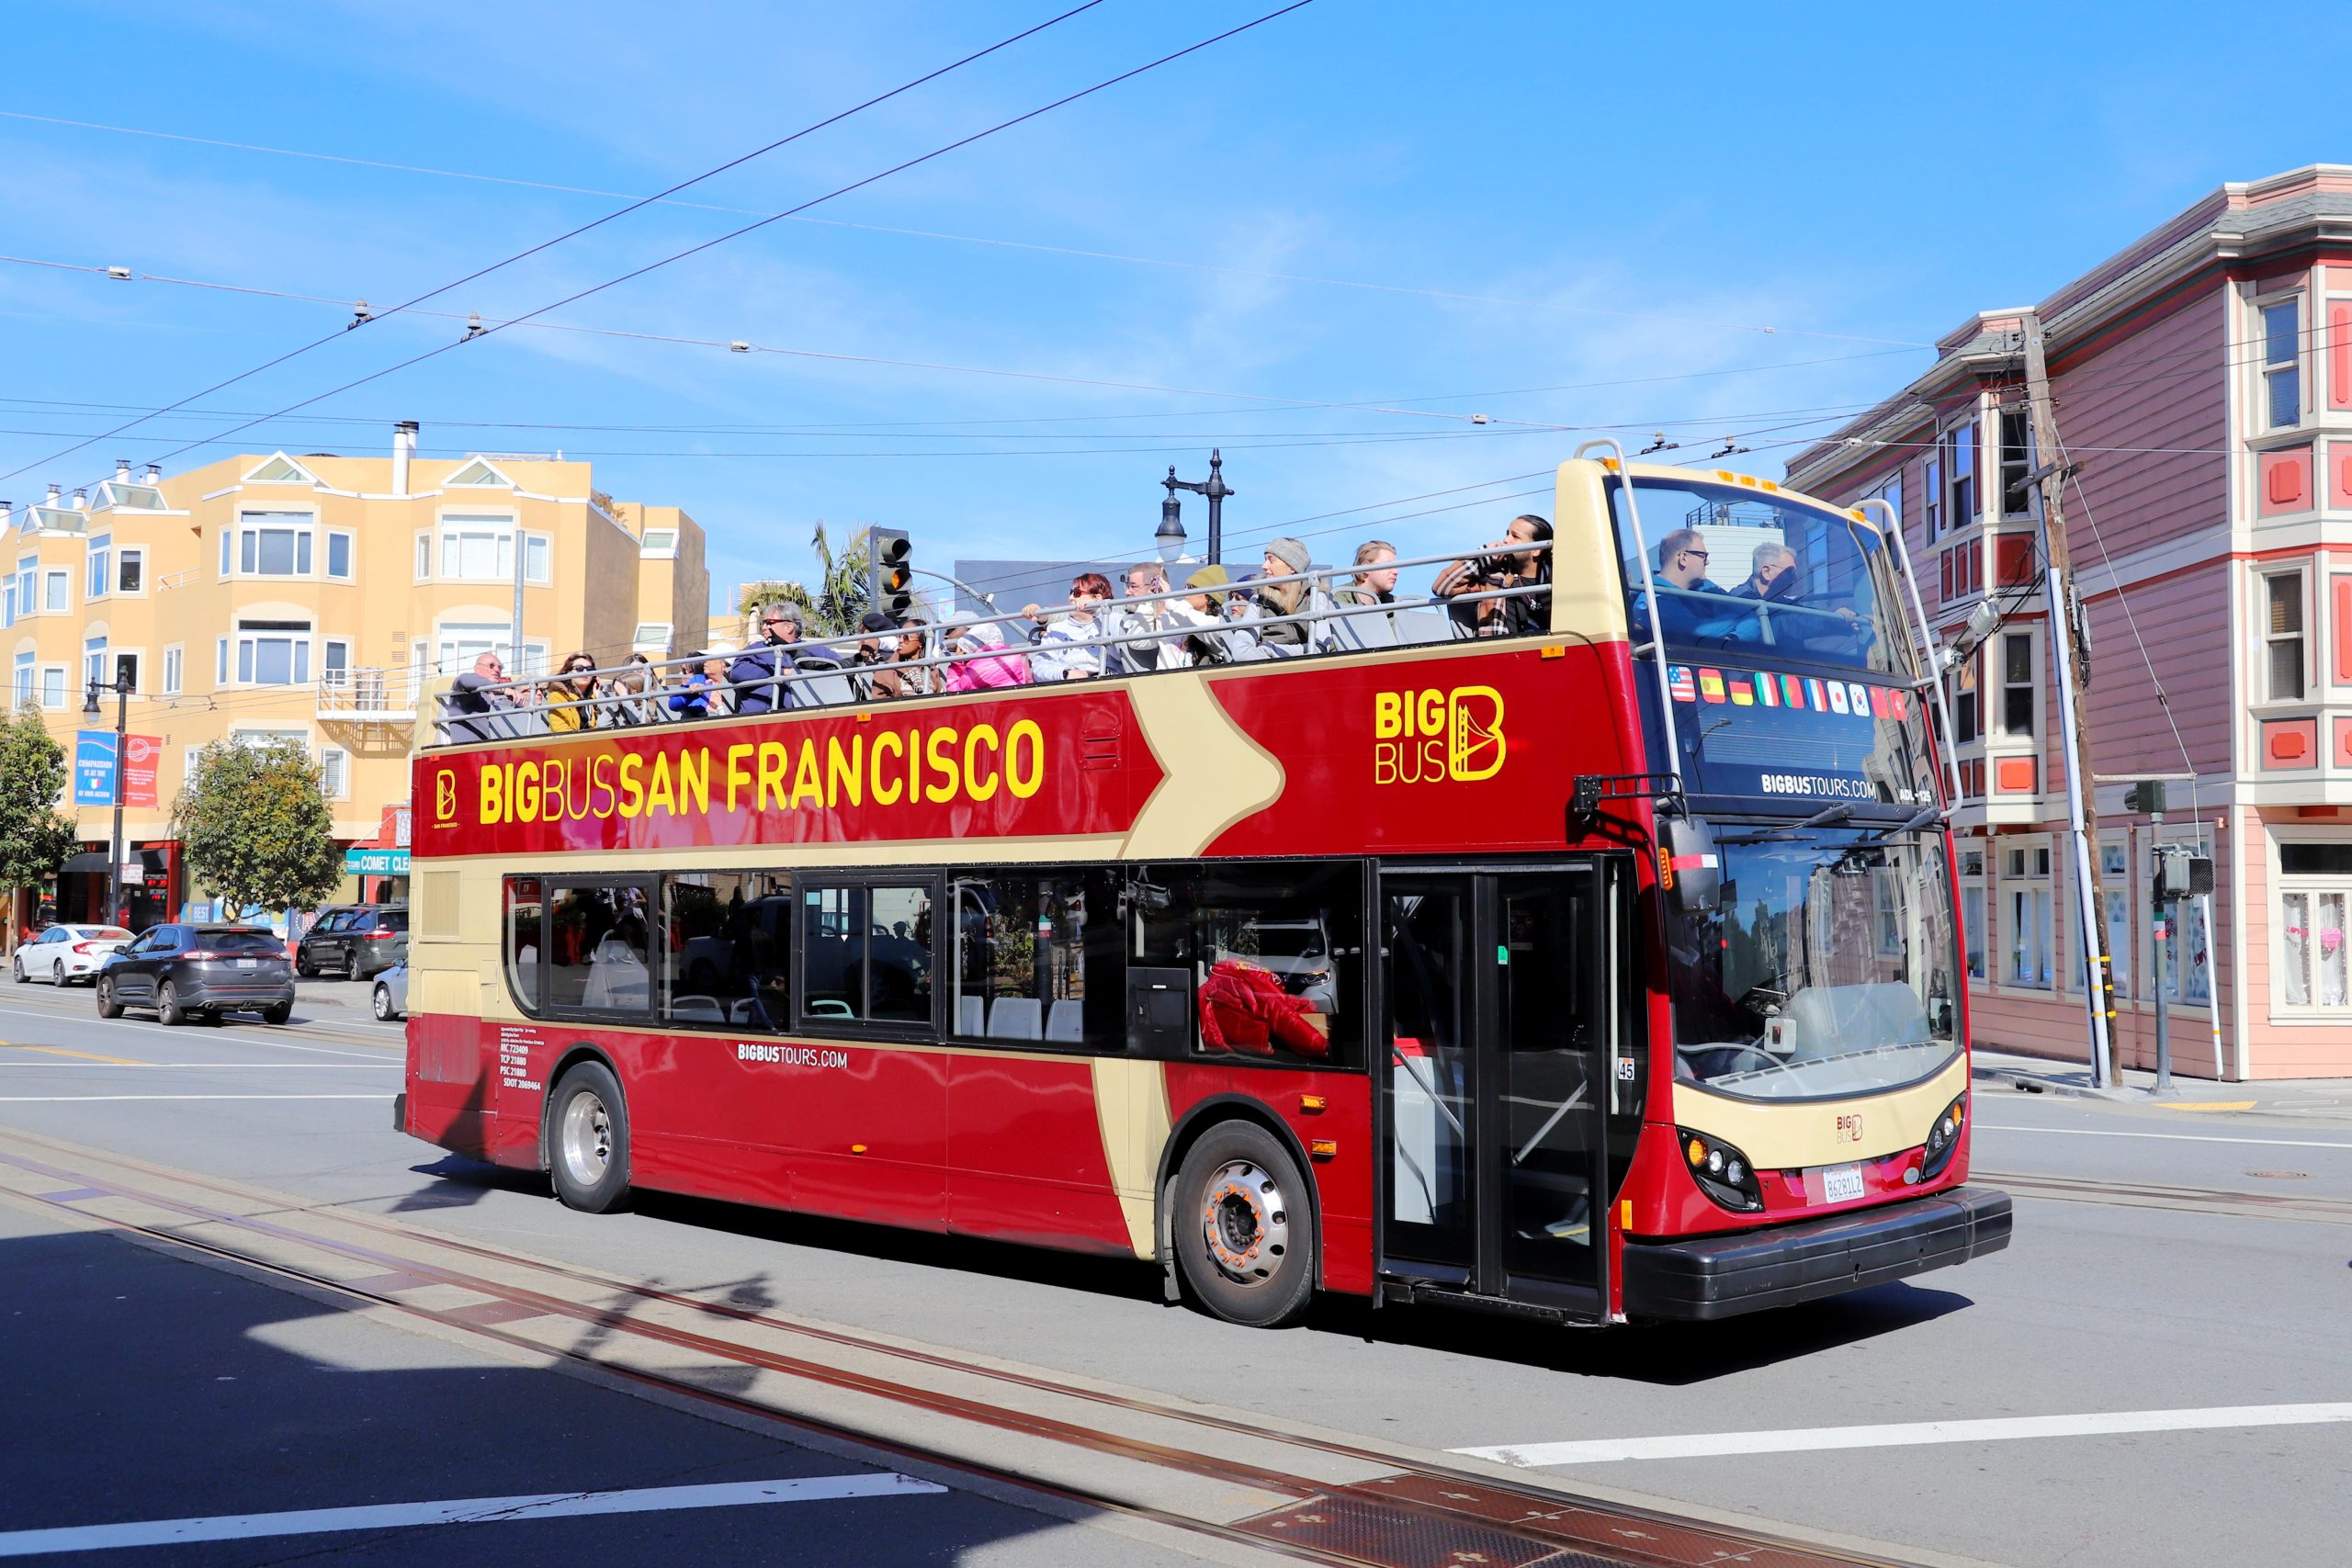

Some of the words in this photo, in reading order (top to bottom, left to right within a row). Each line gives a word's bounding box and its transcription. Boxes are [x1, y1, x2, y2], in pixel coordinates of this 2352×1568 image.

[1375, 689, 1445, 739] BIG
[78, 760, 113, 769] COMPASSION
[727, 719, 1045, 813] FRANCISCO
[1375, 739, 1445, 784] BUS
[1761, 773, 1877, 799] BIGBUSTOURS.COM
[361, 855, 390, 871] COMET
[392, 856, 411, 872] CLE
[194, 906, 209, 919] BEST
[738, 1043, 848, 1068] BIGBUSTOURS.COM
[1620, 1063, 1633, 1078] 45
[1837, 1115, 1851, 1130] BIG
[1837, 1130, 1852, 1144] BUS
[1827, 1175, 1862, 1197] 86281L2
